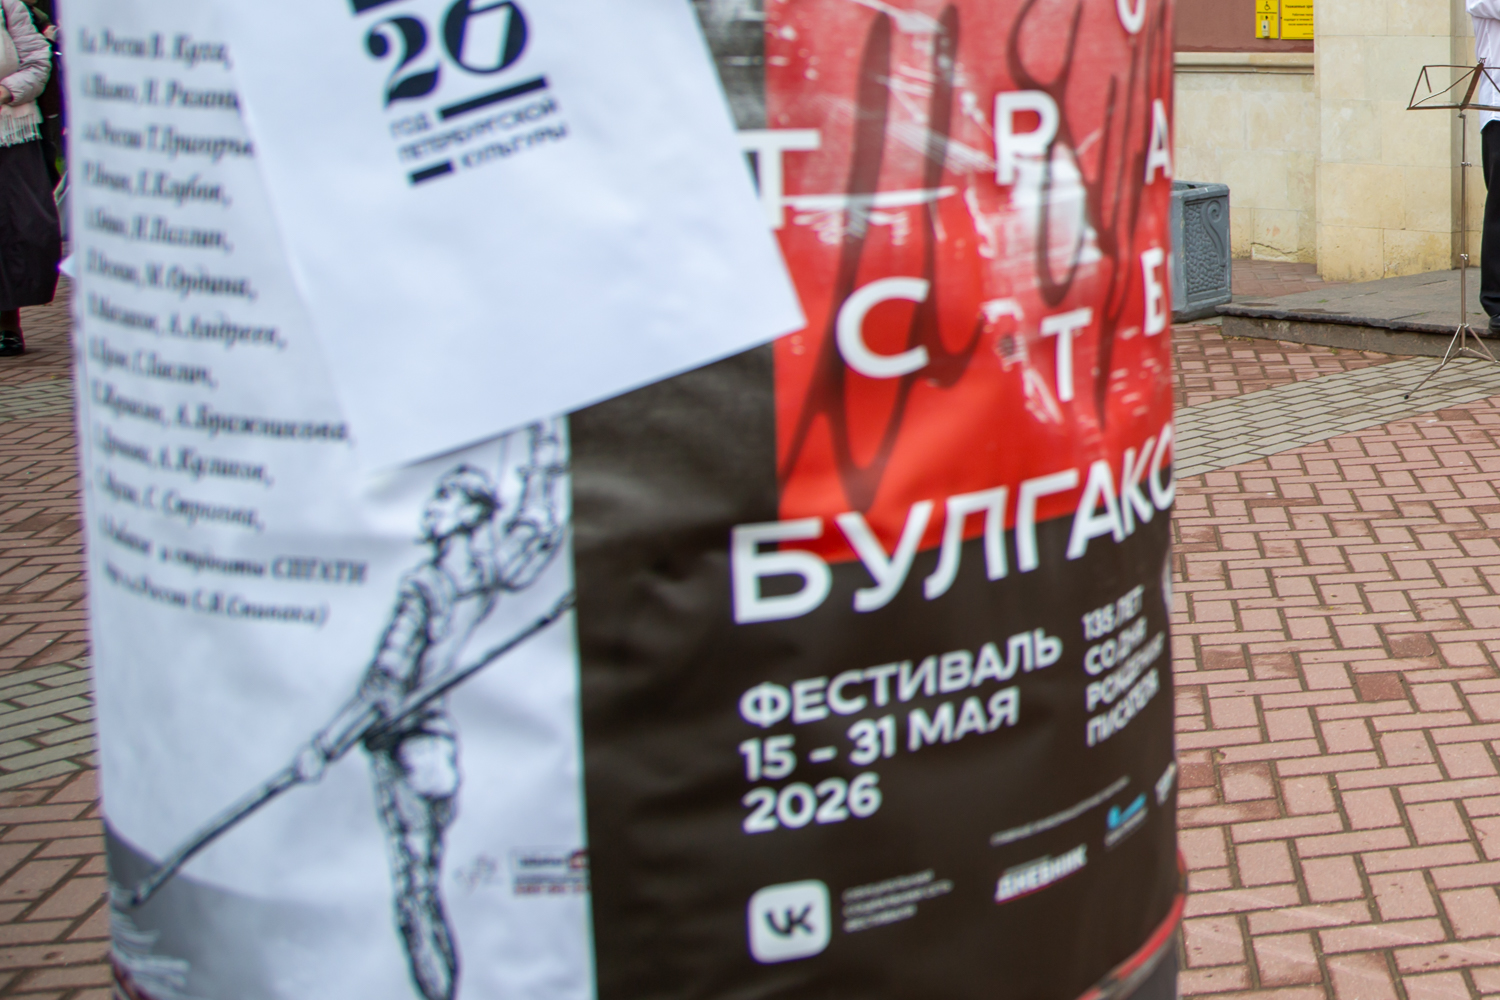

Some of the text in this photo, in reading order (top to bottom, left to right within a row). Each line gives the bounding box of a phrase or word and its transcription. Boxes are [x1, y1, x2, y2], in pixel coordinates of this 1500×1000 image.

[1082, 603, 1114, 640] 135
[739, 628, 1063, 728] ФЕСТИВАЛЬ
[1084, 639, 1117, 676] СО
[739, 735, 797, 783] 15
[848, 722, 897, 768] 31
[907, 686, 1021, 753] МАЯ
[742, 773, 882, 835] 2026
